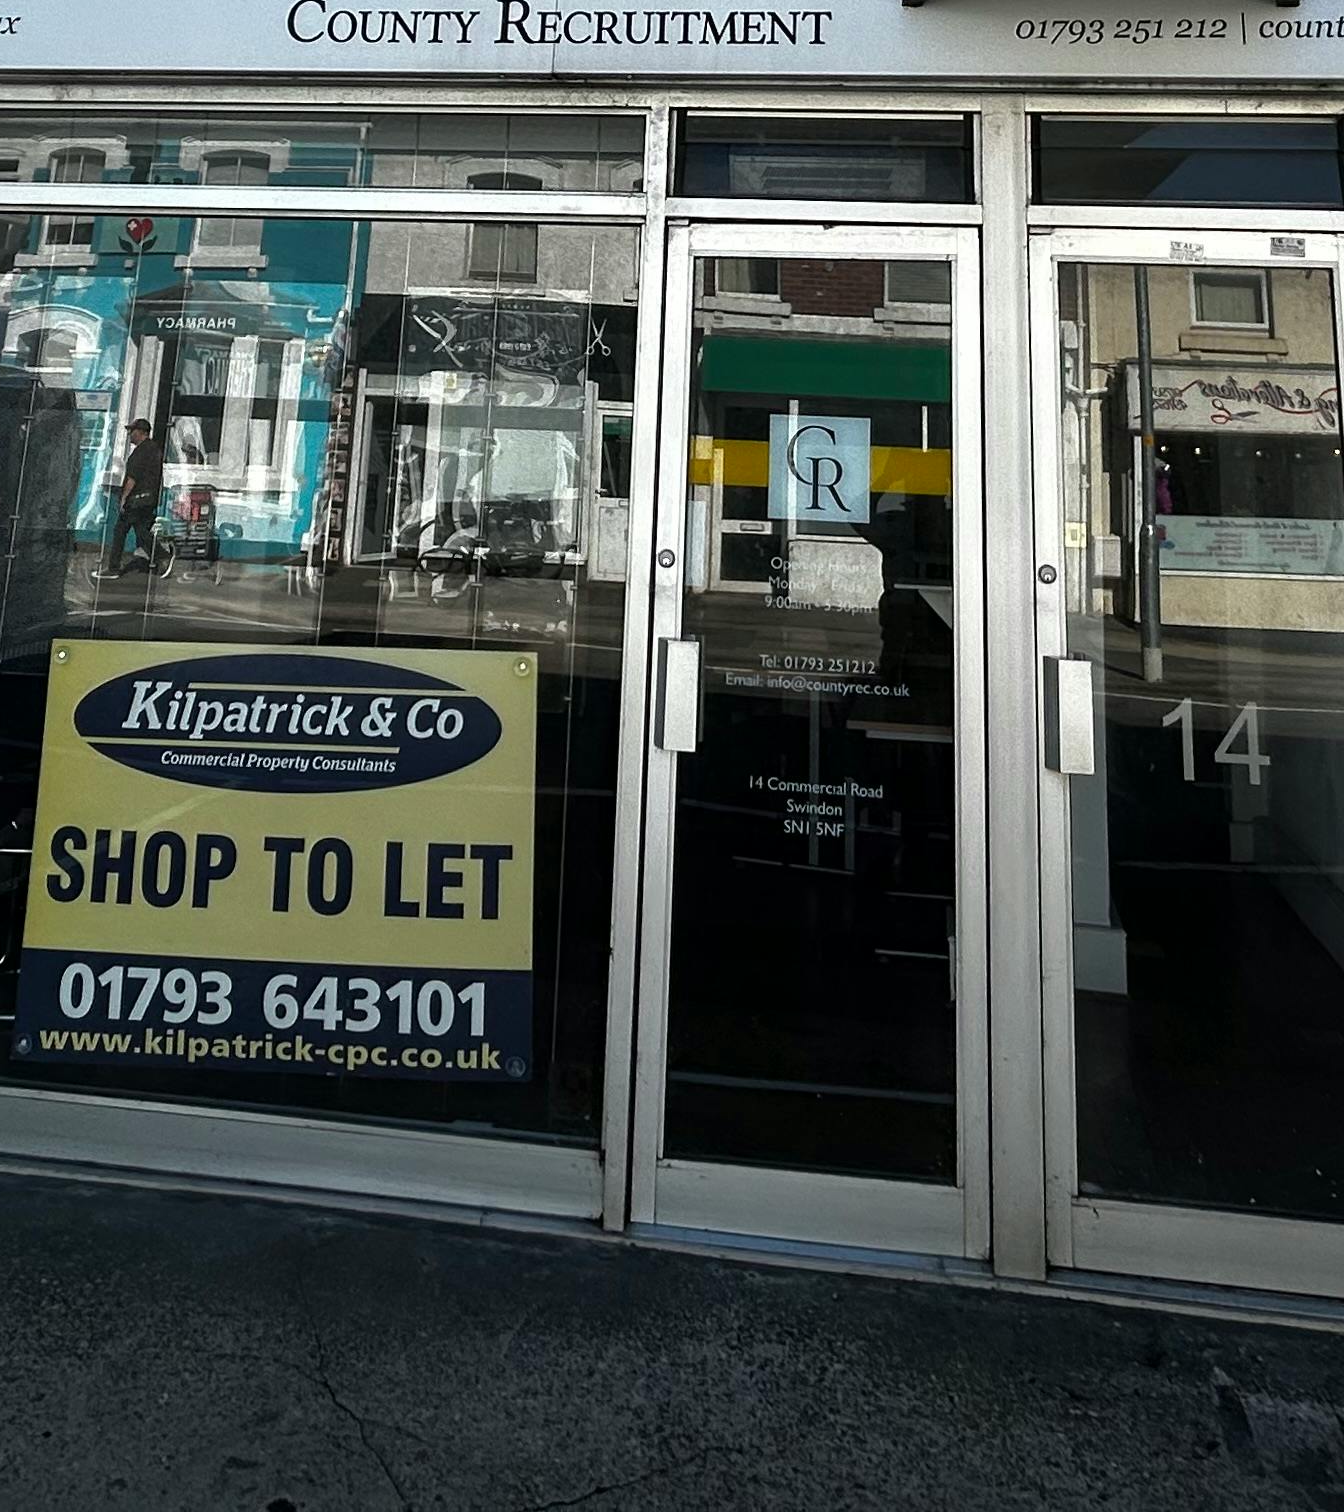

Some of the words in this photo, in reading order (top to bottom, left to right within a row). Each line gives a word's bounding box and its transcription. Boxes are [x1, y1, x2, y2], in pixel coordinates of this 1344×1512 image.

[1015, 19, 1103, 45] 01793
[1113, 20, 1164, 44] 251
[1175, 20, 1227, 39] 212
[771, 557, 824, 575] Opening
[829, 560, 867, 574] Hours
[768, 576, 818, 593] Monday
[764, 595, 811, 610] 9:00am
[759, 654, 781, 670] Tel:
[784, 656, 824, 672] 01793
[828, 658, 876, 675] 251212
[725, 673, 764, 689] Email:
[767, 675, 910, 699] info@countyrec.co.uk
[122, 679, 354, 739] Kilpatrick
[363, 698, 398, 737] &
[406, 698, 464, 739] Co
[1161, 697, 1271, 786] 14
[161, 751, 245, 769] Commercial
[247, 753, 310, 772] Property
[313, 756, 396, 773] Consultants
[748, 775, 764, 791] 14
[767, 777, 847, 797] Commercial
[850, 782, 884, 799] Road
[786, 799, 843, 817] Swindon
[783, 819, 811, 835] SN1
[815, 821, 845, 837] 5NF
[46, 825, 237, 909] SHOP
[263, 836, 353, 916] TO
[383, 841, 513, 920] LET
[59, 962, 232, 1025] 01793
[263, 974, 486, 1037] 643101
[40, 1027, 501, 1073] www.kilpatrick-cpc.co.uk
